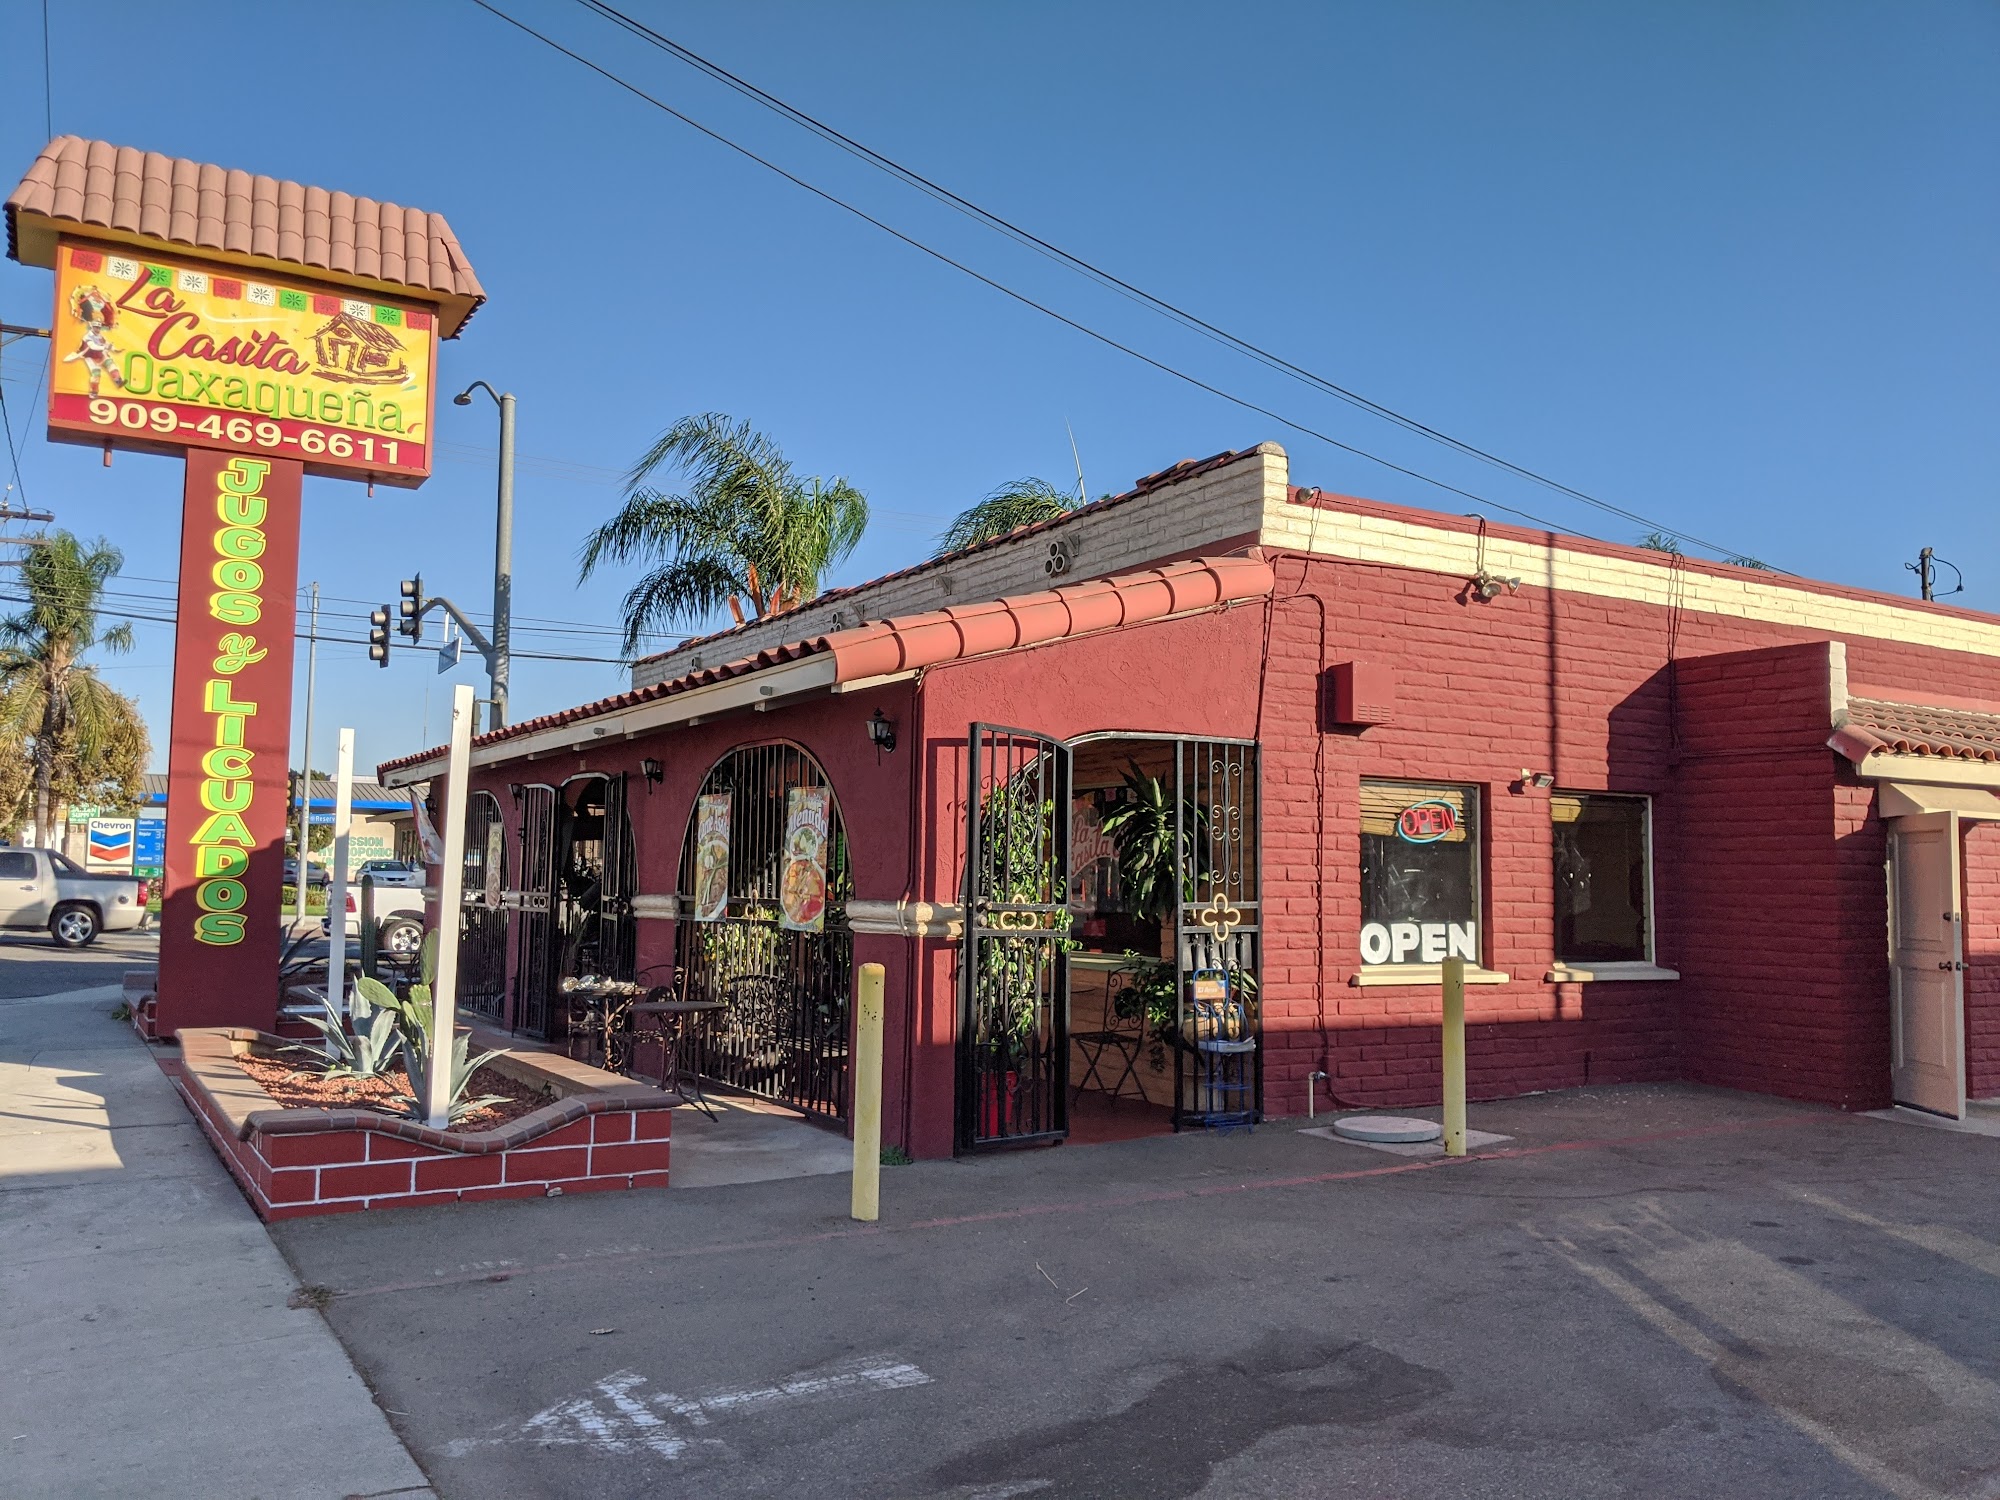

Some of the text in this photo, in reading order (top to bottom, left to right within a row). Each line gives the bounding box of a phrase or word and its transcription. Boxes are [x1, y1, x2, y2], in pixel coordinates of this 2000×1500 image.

[116, 267, 186, 319] La
[149, 311, 311, 376] Casita
[123, 351, 406, 434] Oaxaqueña
[89, 398, 400, 466] 909-469-6611
[189, 458, 271, 947] JUGOS y LICUADOS
[91, 820, 132, 830] Chevron
[315, 815, 335, 823] Reserv
[1400, 807, 1456, 836] OPEN
[318, 847, 392, 857] HYOPONIC
[349, 837, 383, 847] SSION
[1360, 922, 1476, 965] OPEN
